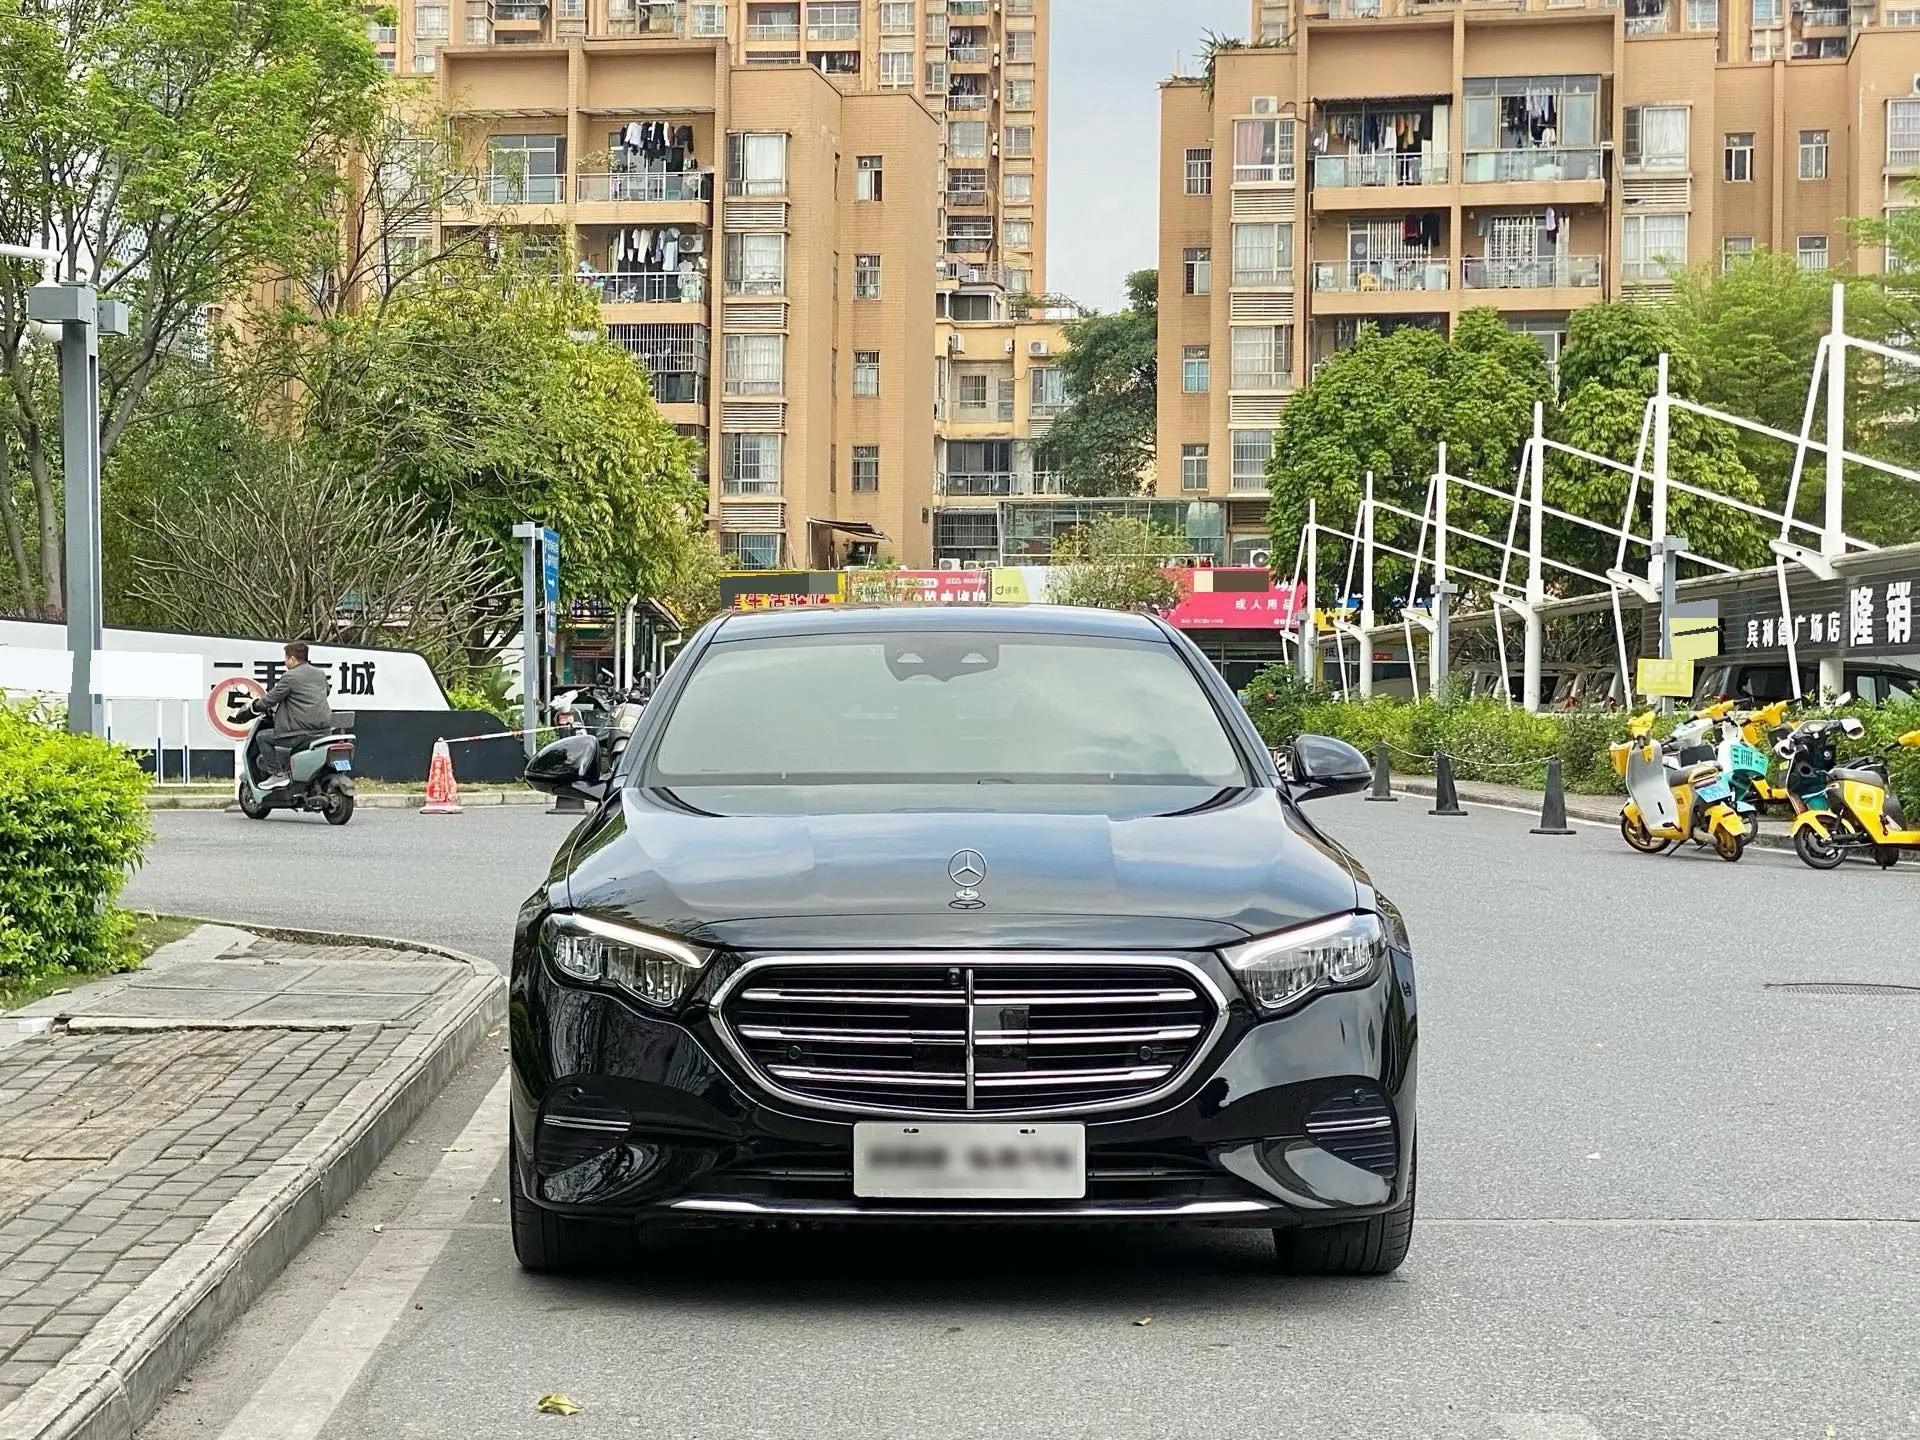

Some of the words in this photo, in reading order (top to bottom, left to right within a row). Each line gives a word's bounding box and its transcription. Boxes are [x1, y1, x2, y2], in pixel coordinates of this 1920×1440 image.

[1235, 598, 1292, 611] 成人用品
[1850, 581, 1912, 648] 隆销
[211, 660, 376, 696] 二手城
